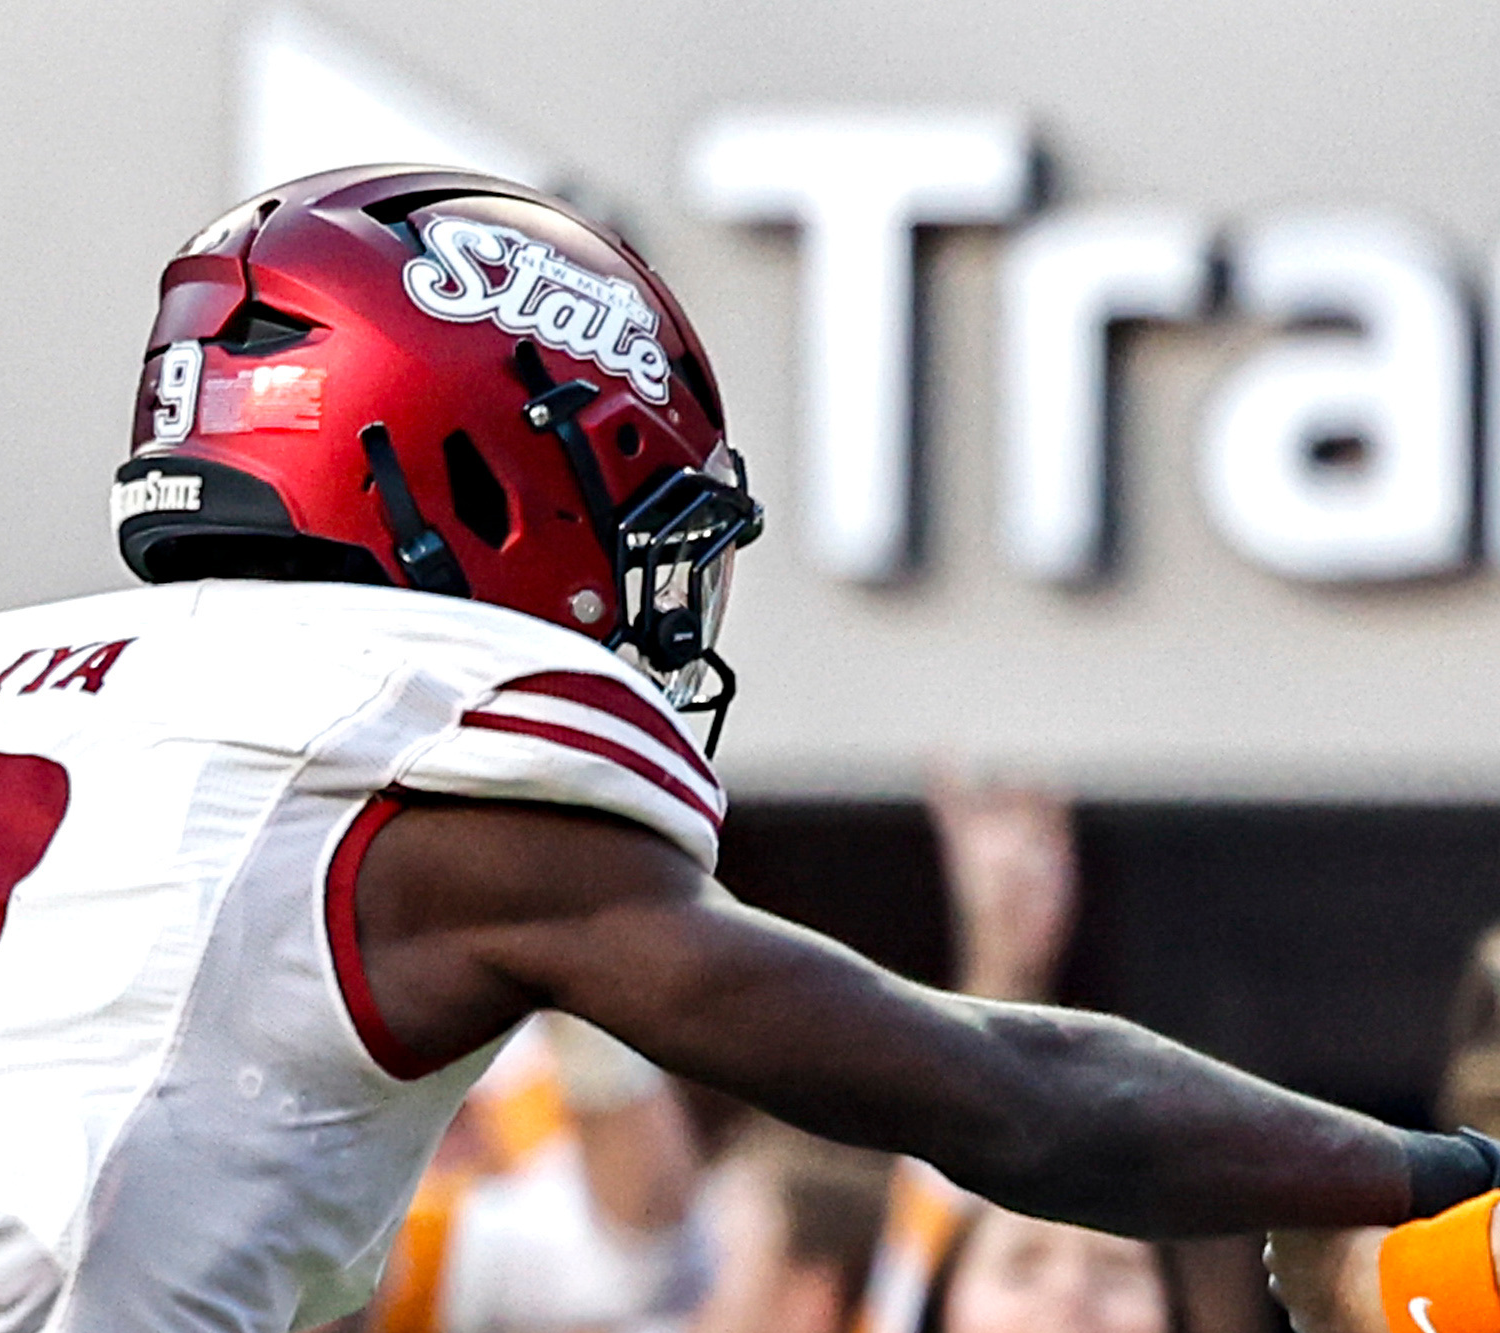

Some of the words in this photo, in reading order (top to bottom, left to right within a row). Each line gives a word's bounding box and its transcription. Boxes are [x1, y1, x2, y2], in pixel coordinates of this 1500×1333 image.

[403, 214, 672, 406] State
[520, 253, 568, 282] NEW
[575, 274, 654, 326] MEXICO
[153, 339, 204, 443] 9
